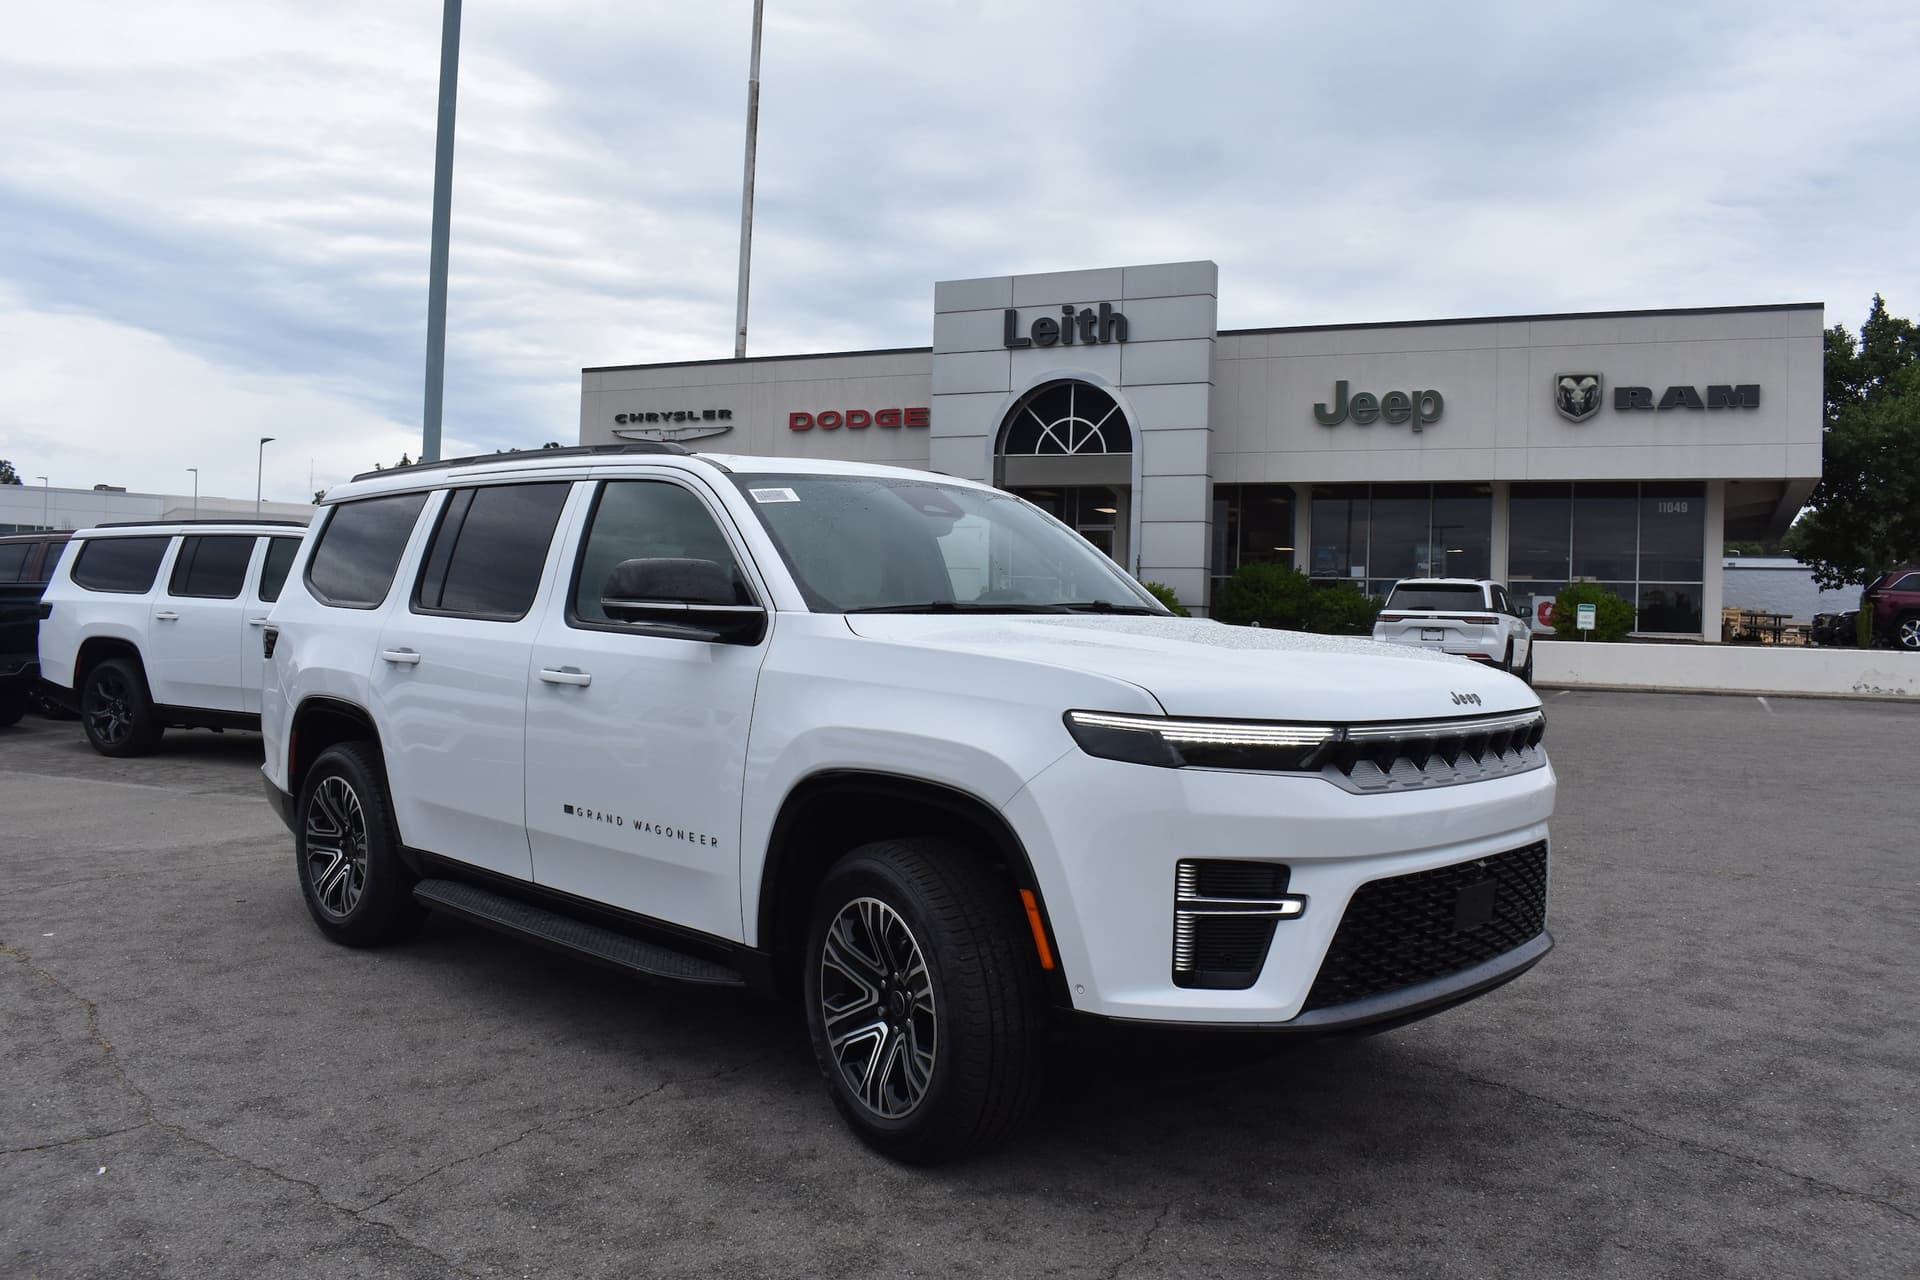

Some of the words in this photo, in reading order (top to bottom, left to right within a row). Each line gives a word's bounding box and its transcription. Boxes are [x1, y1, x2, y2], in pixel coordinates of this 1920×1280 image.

[1004, 302, 1128, 348] Leith
[1313, 379, 1444, 432] Jeep
[1614, 384, 1760, 410] RAM
[614, 409, 733, 424] CHRYSLER
[789, 407, 930, 431] DODGE
[1658, 501, 1688, 513] 11049
[1450, 690, 1482, 706] Jeep
[576, 807, 623, 826] GRAND
[633, 819, 718, 848] WAGONEER
